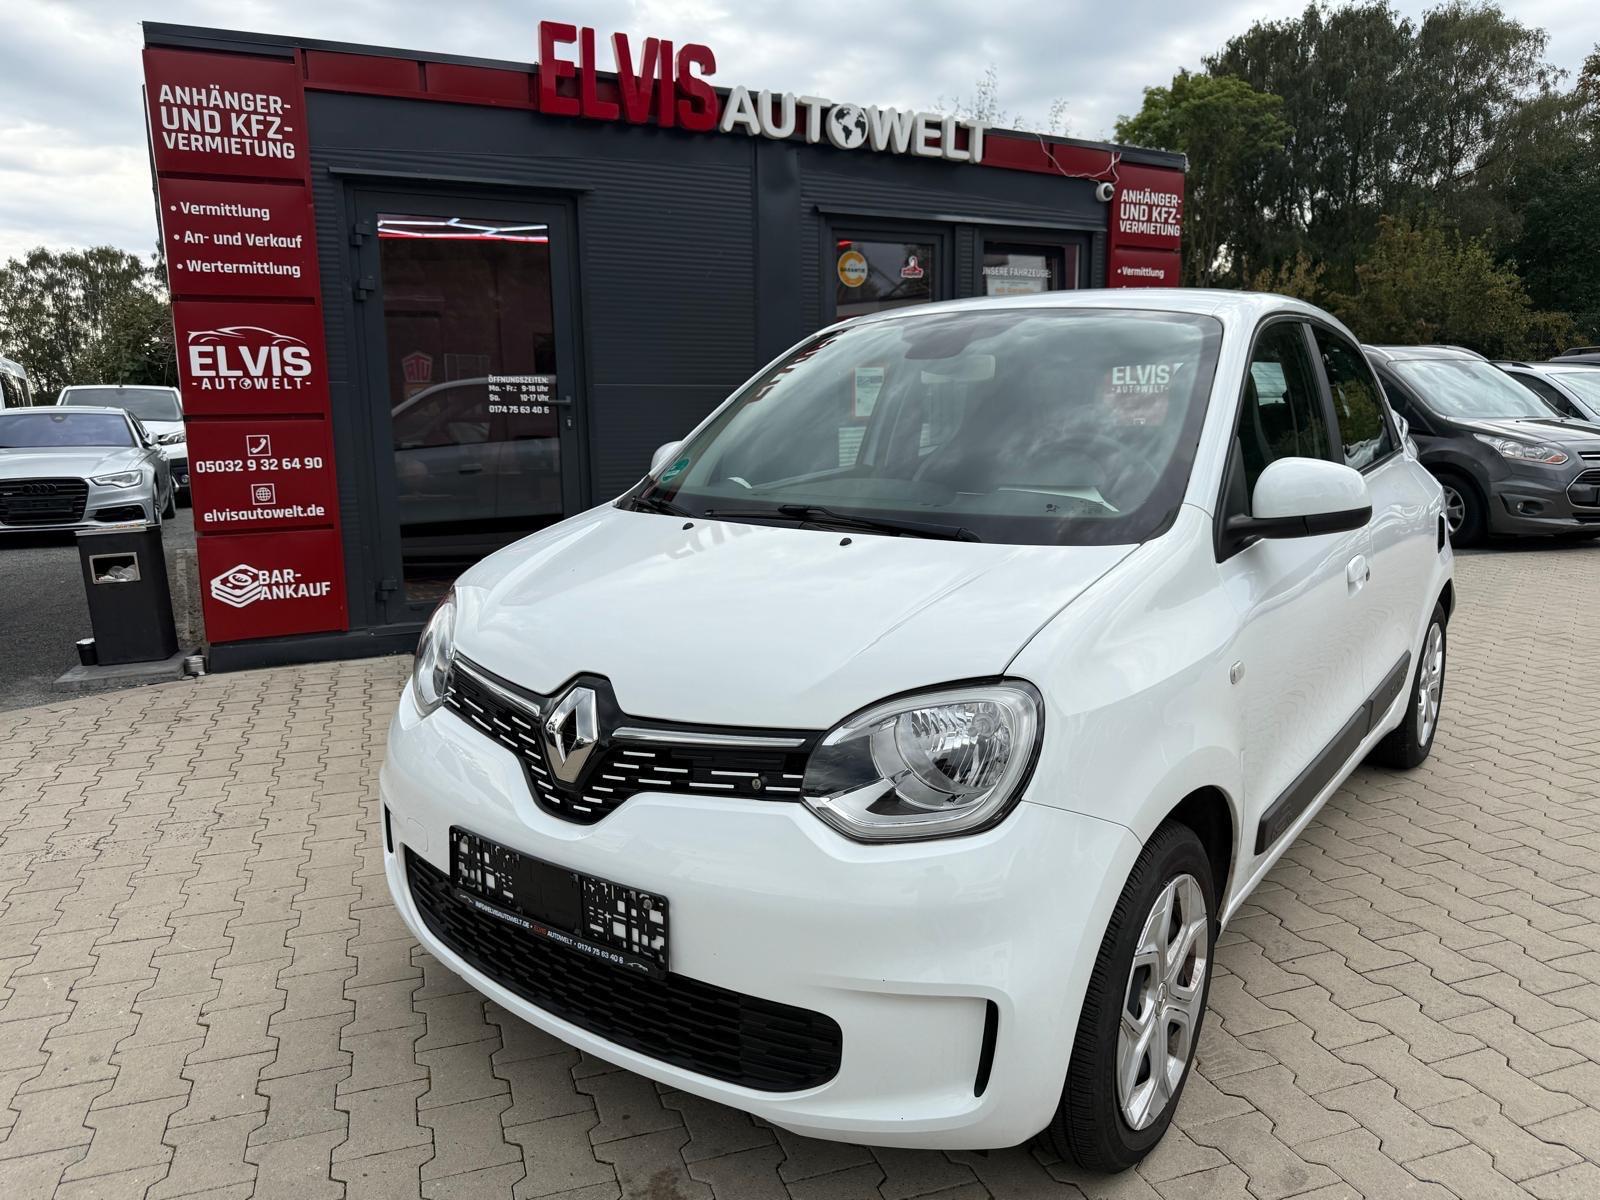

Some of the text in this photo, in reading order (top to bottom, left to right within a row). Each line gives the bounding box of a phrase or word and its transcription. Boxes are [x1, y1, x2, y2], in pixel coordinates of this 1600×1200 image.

[159, 84, 291, 115] ANHÄNGER-
[538, 20, 992, 164] ELVIS AUTOWELT
[160, 106, 293, 139] UND KFZ-
[162, 131, 295, 159] VERMIETUNG
[1120, 188, 1182, 207] ANHÄNGER-
[180, 201, 270, 221] Vermittlung
[1120, 203, 1181, 224] UND KFZ-
[1119, 220, 1181, 236] VERMIETUNG
[184, 230, 303, 248] An- und Verkauf
[186, 259, 301, 278] Wertermittlung
[1122, 266, 1165, 279] Vermittlung
[188, 345, 312, 377] ELVIS
[1112, 364, 1170, 385] ELVIS
[488, 384, 501, 392] Mo.
[520, 393, 536, 402] 10-17
[537, 394, 550, 402] Uhr
[489, 405, 550, 414] 0174 75 63 40 6
[196, 456, 323, 474] 05032 9 32 64 90
[203, 503, 325, 523] elvisautowelt.de
[258, 568, 302, 585] BAR-
[259, 581, 331, 601] ANKAUF
[547, 930, 573, 945] AUTOWELT
[577, 942, 592, 953] 0174
[592, 946, 601, 956] 75
